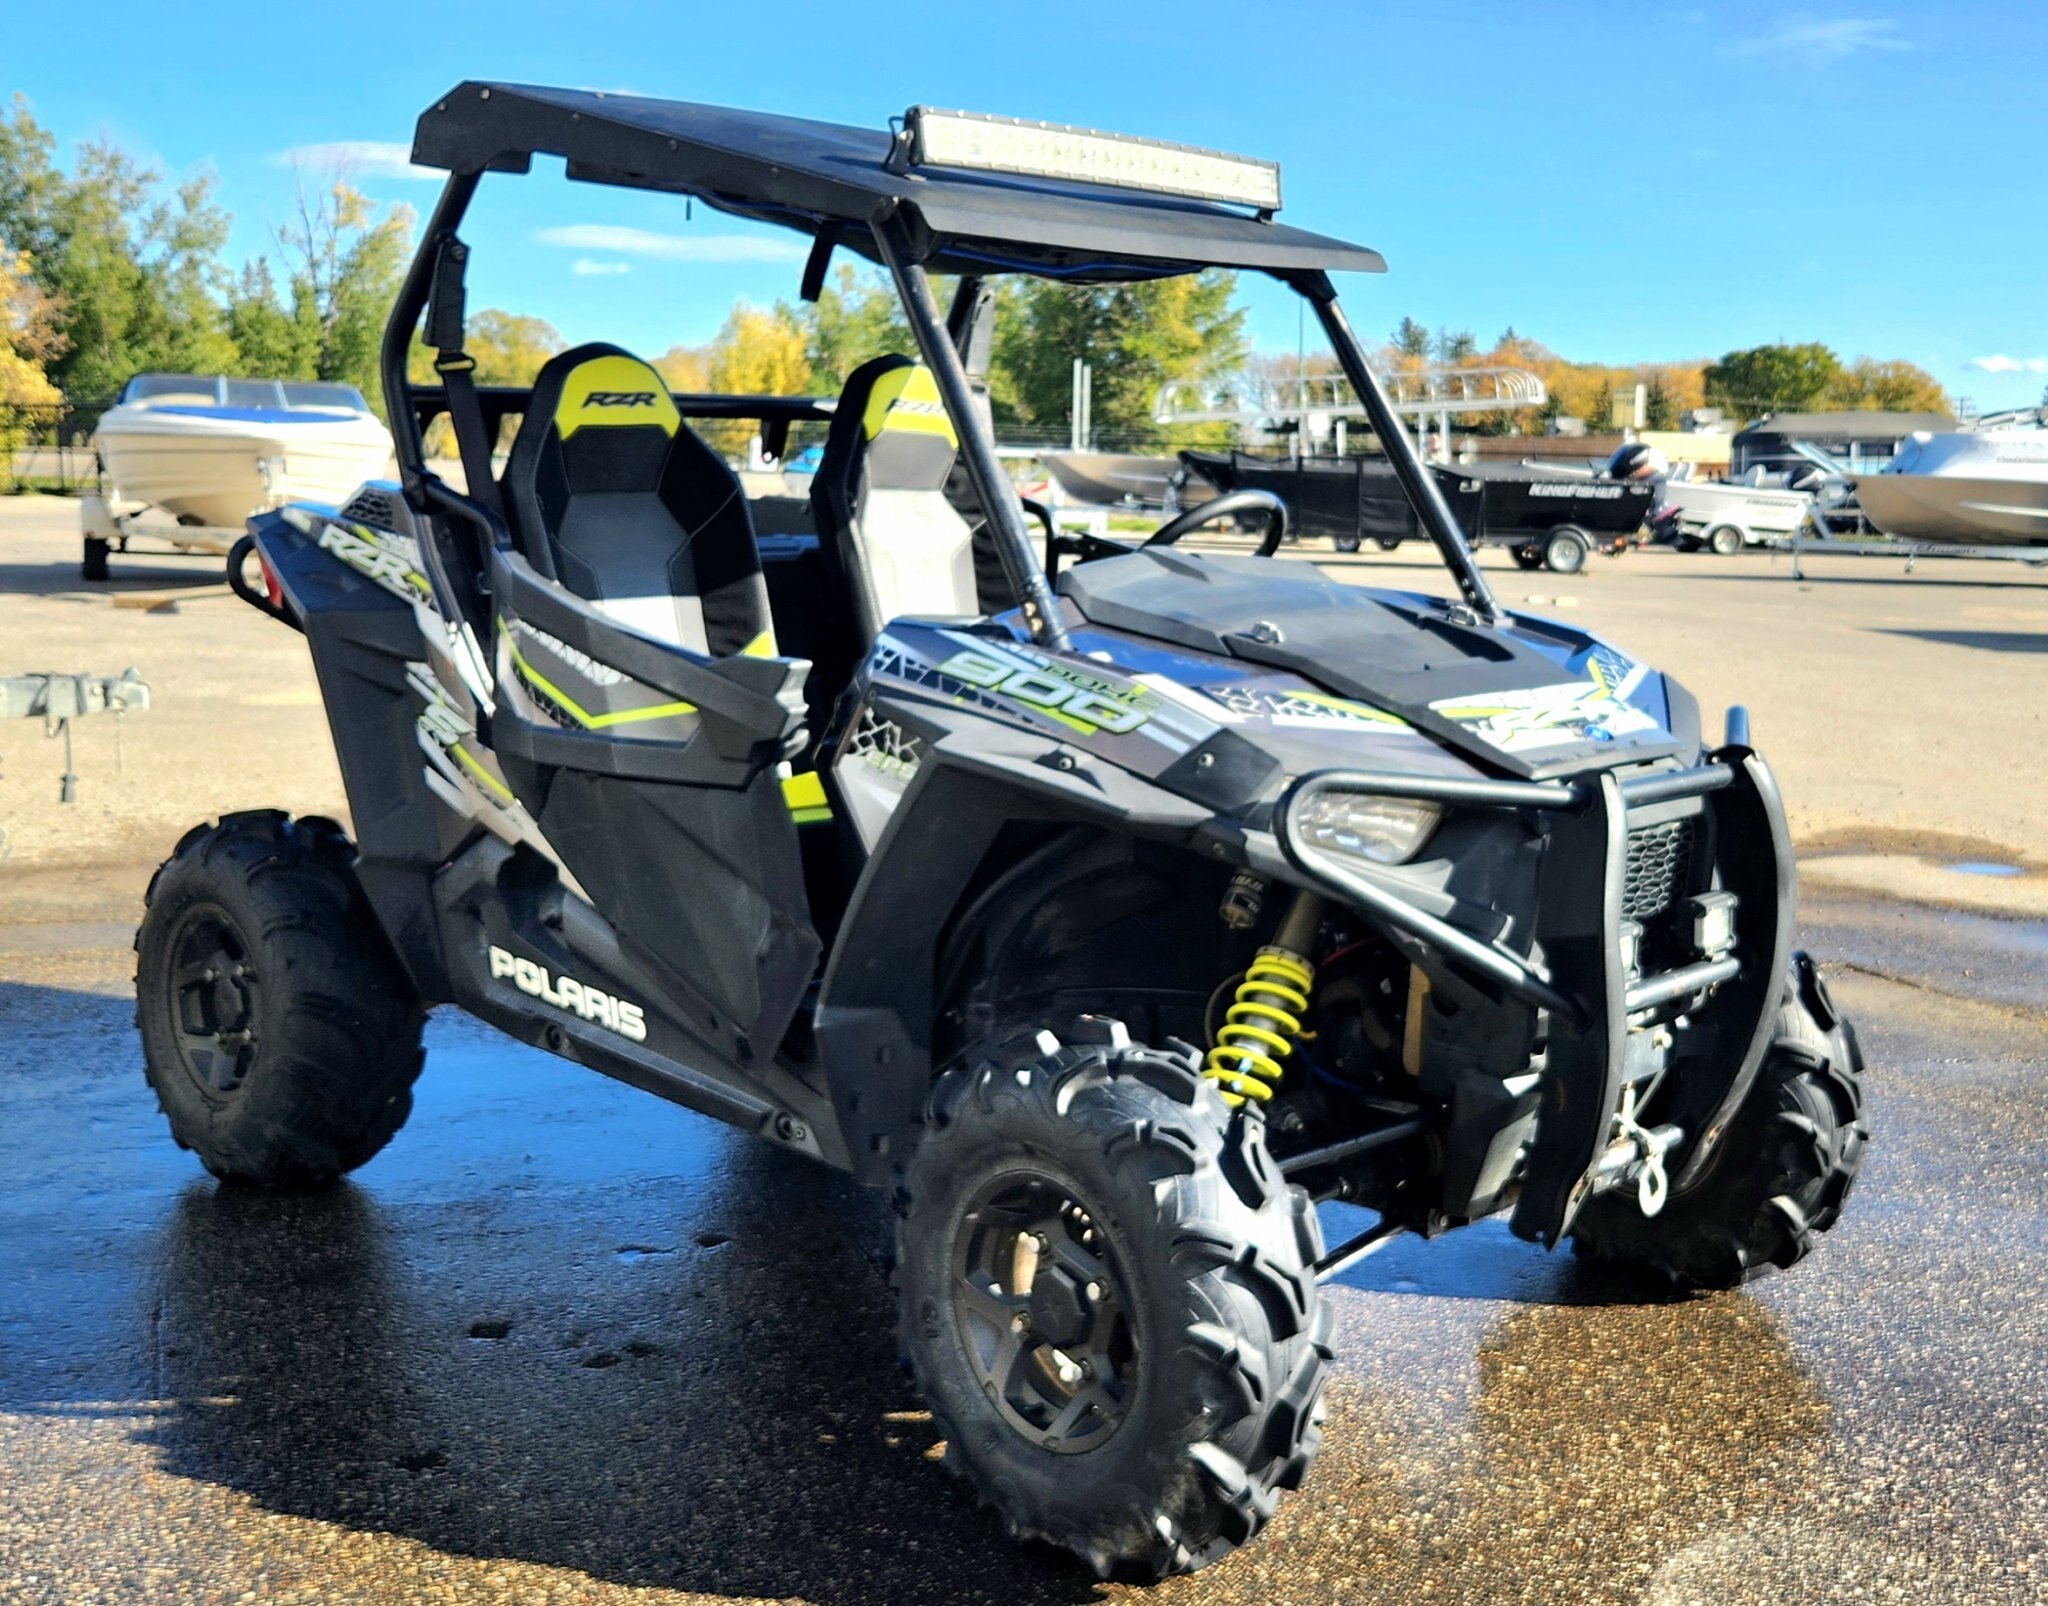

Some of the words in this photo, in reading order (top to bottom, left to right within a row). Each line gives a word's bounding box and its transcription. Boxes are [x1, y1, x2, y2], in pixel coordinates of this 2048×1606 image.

[581, 391, 656, 408] RZR
[318, 523, 412, 595] RZR
[934, 651, 1150, 735] 900
[488, 944, 647, 1042] POLARIS
